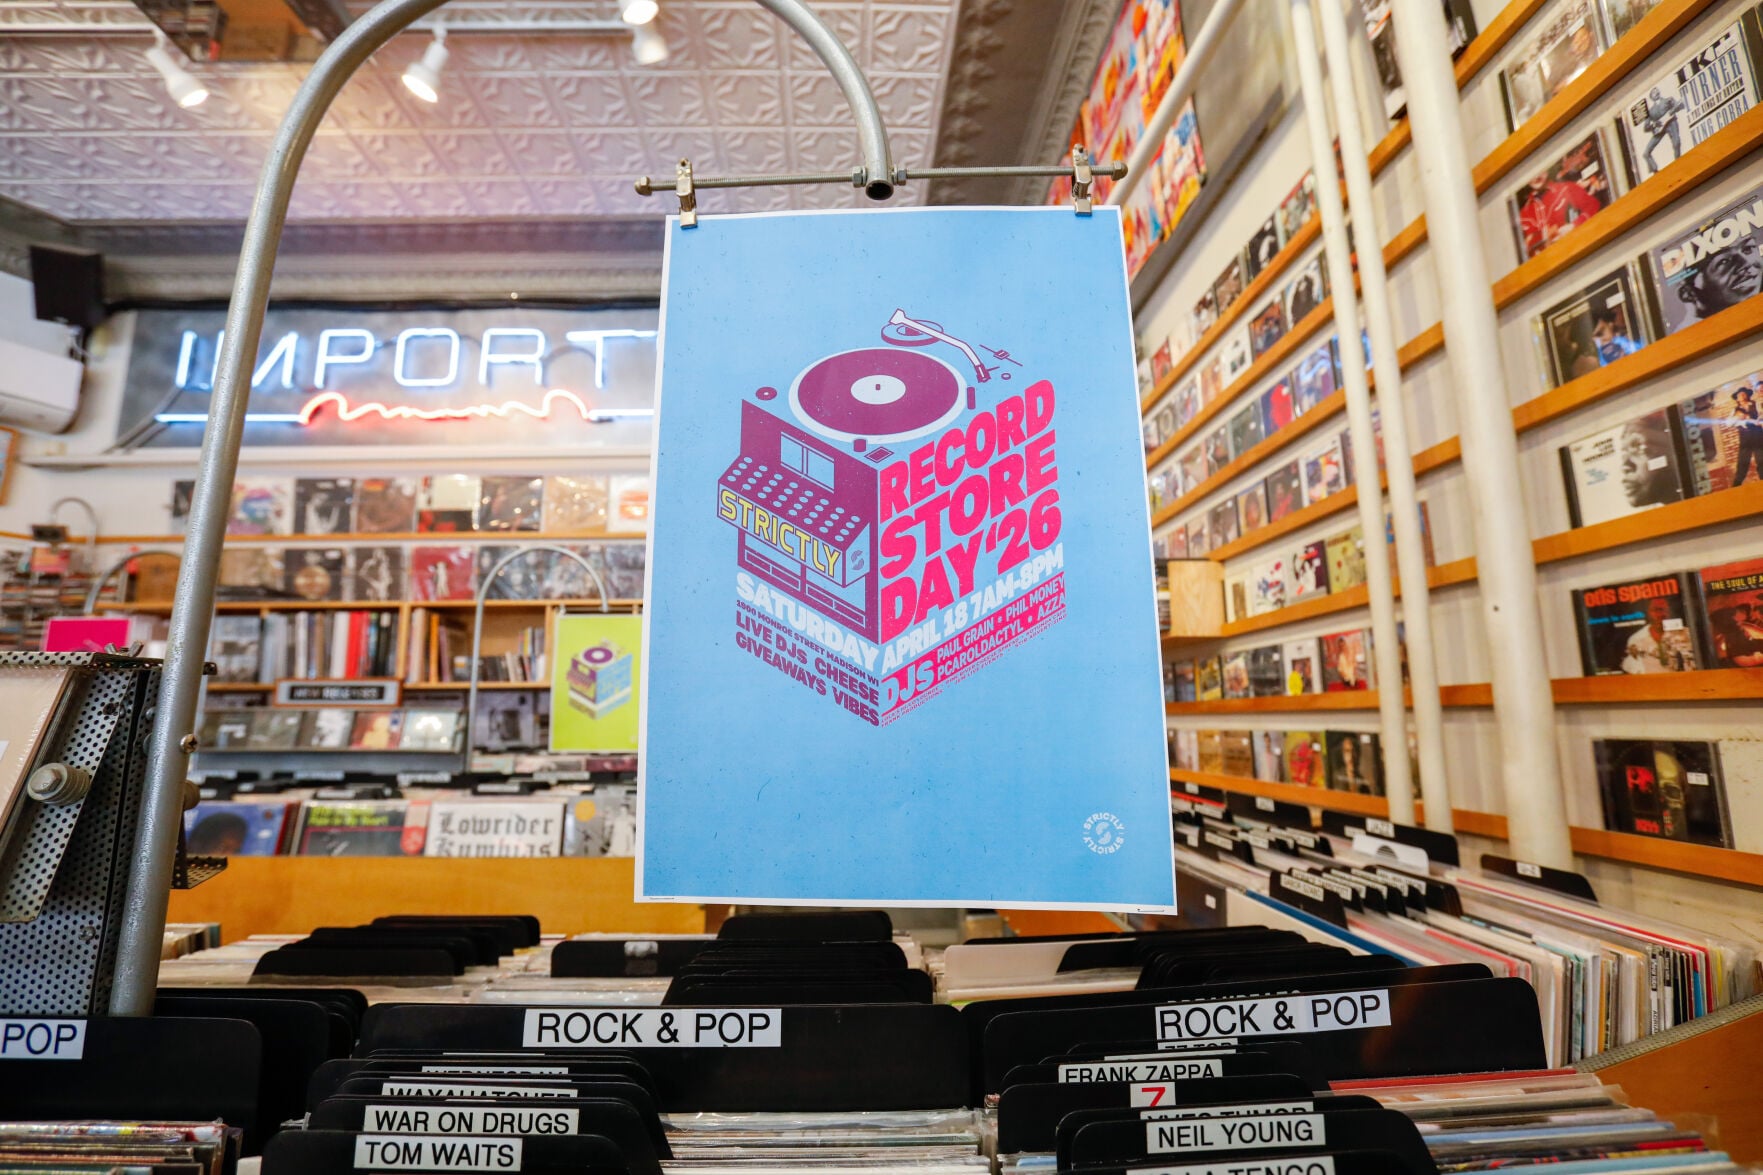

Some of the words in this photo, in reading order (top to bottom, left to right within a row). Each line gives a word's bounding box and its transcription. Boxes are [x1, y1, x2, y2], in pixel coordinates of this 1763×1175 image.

[1679, 49, 1743, 113] TURNER
[1661, 199, 1763, 278] DIXON
[880, 379, 1055, 525] RECORD
[720, 488, 841, 577] STRICTLY
[880, 429, 1058, 580] STORE
[881, 531, 983, 645] DAY
[881, 618, 941, 675] APRIL
[944, 601, 968, 637] 18
[970, 542, 1064, 620] 7AM-8PM
[1618, 578, 1679, 603] spann
[1726, 577, 1746, 588] SOUL
[736, 572, 879, 672] SATURDAY
[758, 611, 793, 638] MONROE
[794, 631, 825, 655] STREET
[827, 650, 866, 680] MADISON
[867, 674, 879, 687] WI
[937, 638, 962, 663] PAUL
[963, 616, 994, 647] GRAIN
[1006, 597, 1028, 622] PHIL
[1029, 575, 1065, 608] MONEY
[937, 618, 1024, 681] PCAROLDACTYL
[735, 631, 827, 696] GIVEAWAYS
[832, 685, 880, 727] VIBES
[736, 611, 772, 644] LIVE
[815, 657, 879, 706] CHEESE
[438, 812, 554, 836] Lowrider
[1083, 812, 1125, 831] STRICTLY
[1083, 836, 1125, 855] STRICTLY
[1, 1023, 77, 1055] POP
[537, 1013, 643, 1045] ROCK
[656, 1013, 680, 1044] &
[694, 1012, 771, 1044] POP
[1159, 1003, 1262, 1040] ROCK
[1273, 1001, 1296, 1030] &
[1311, 994, 1381, 1027] POP
[1066, 1065, 1138, 1083] FRANK
[1145, 1063, 1216, 1081] ZAPPA
[364, 1141, 423, 1165] TOM
[432, 1142, 515, 1167] WAITS
[374, 1110, 428, 1132] WAR
[438, 1111, 478, 1133] ON
[484, 1111, 570, 1135] DRUGS
[1158, 1124, 1214, 1149] NEIL
[1221, 1120, 1313, 1145] YOUNG
